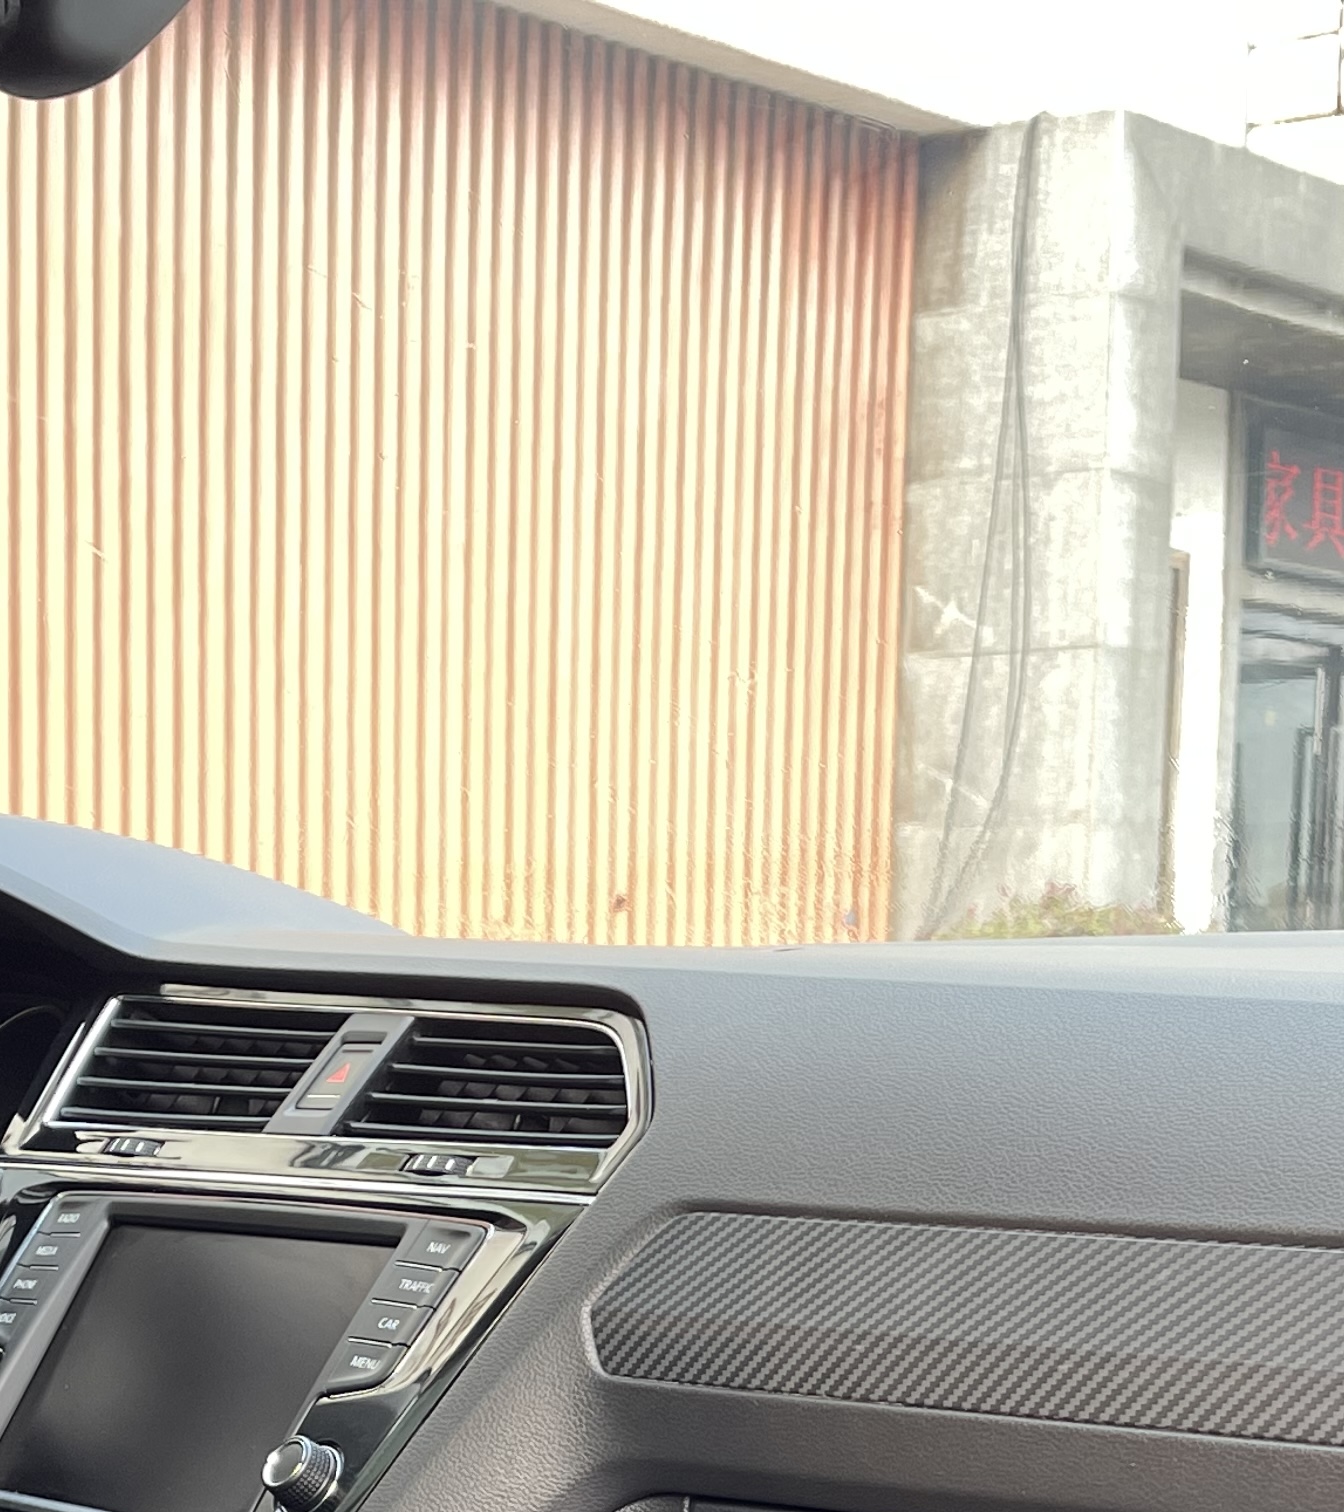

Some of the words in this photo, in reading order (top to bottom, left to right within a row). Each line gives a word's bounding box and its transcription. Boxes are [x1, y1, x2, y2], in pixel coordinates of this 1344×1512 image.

[426, 1241, 451, 1254] NAV
[399, 1279, 435, 1294] TRAFFIC
[377, 1317, 400, 1330] CAR
[350, 1355, 381, 1370] MENU
